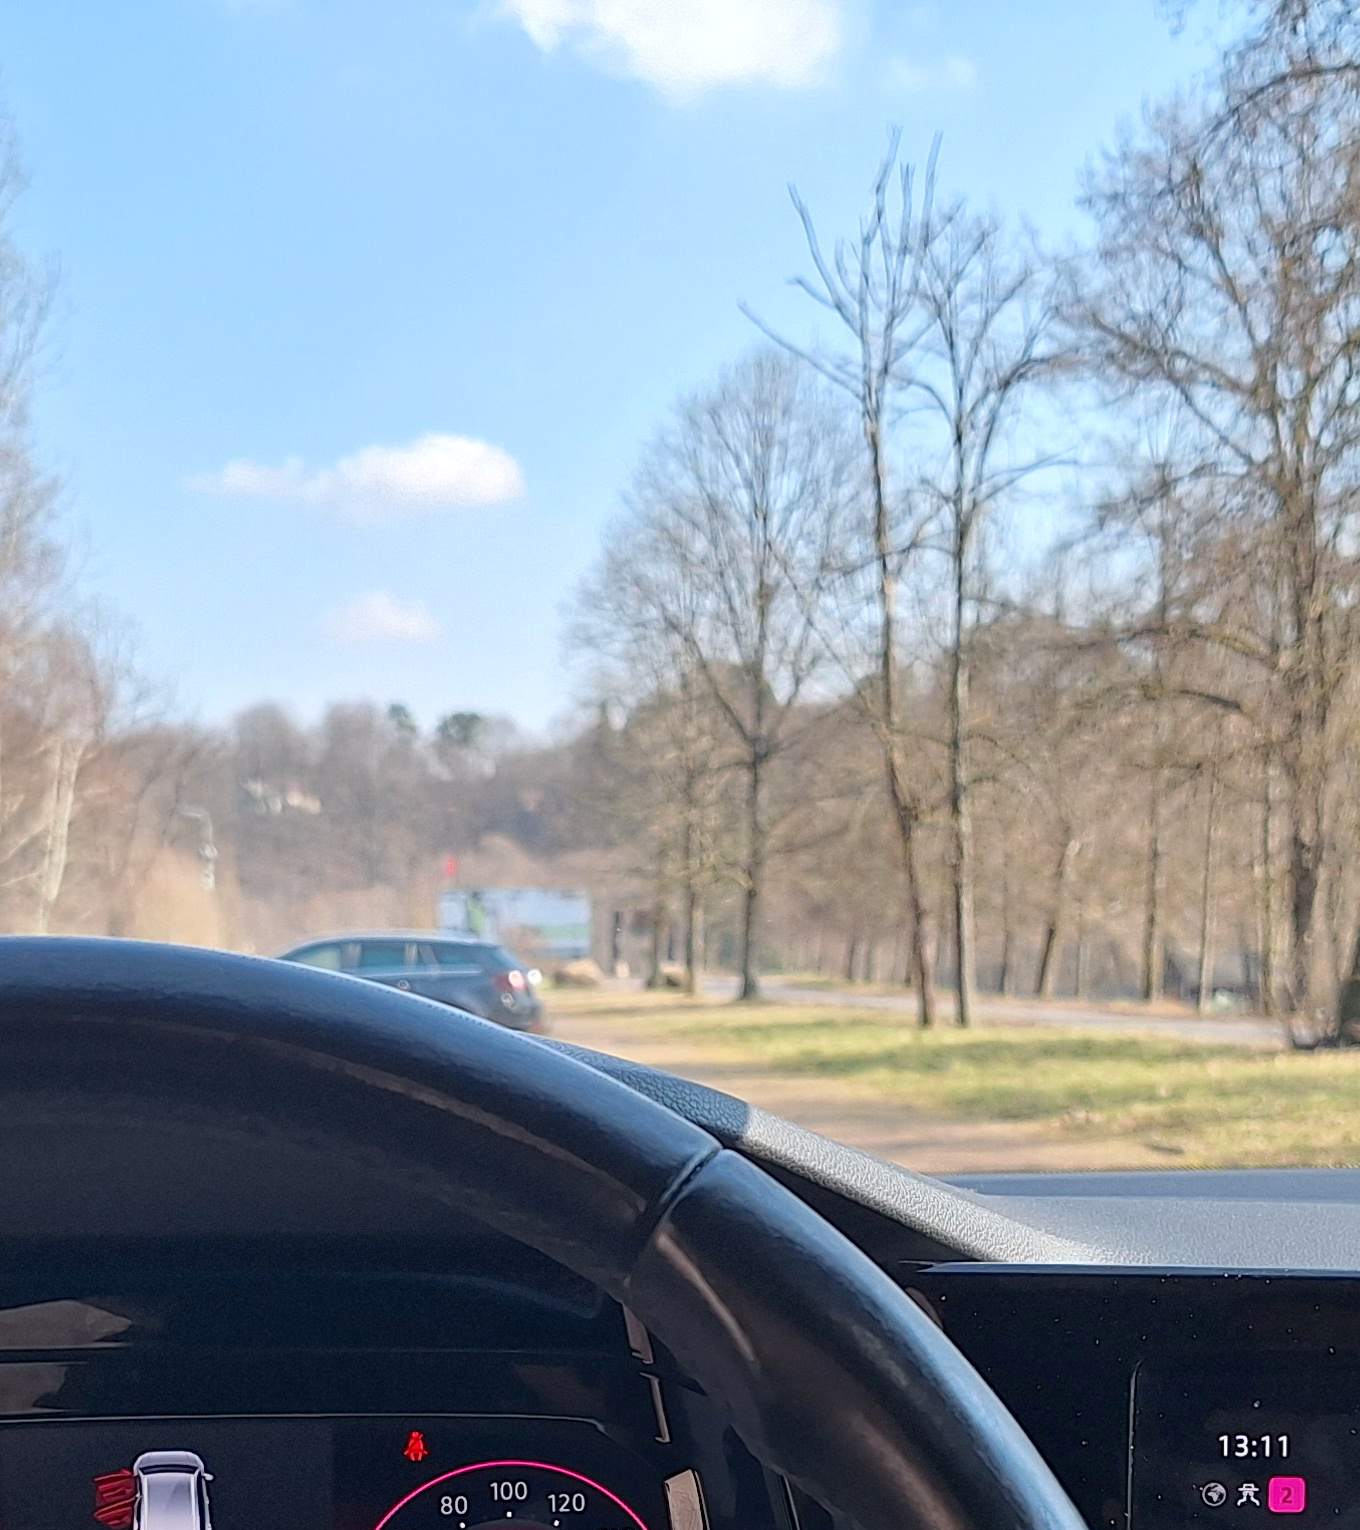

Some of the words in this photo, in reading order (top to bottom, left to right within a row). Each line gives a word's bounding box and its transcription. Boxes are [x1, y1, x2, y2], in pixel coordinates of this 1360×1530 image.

[1218, 1436, 1289, 1457] 13:11
[490, 1482, 528, 1501] 100
[1280, 1487, 1293, 1505] 2
[440, 1496, 468, 1515] 80
[547, 1493, 585, 1513] 120
